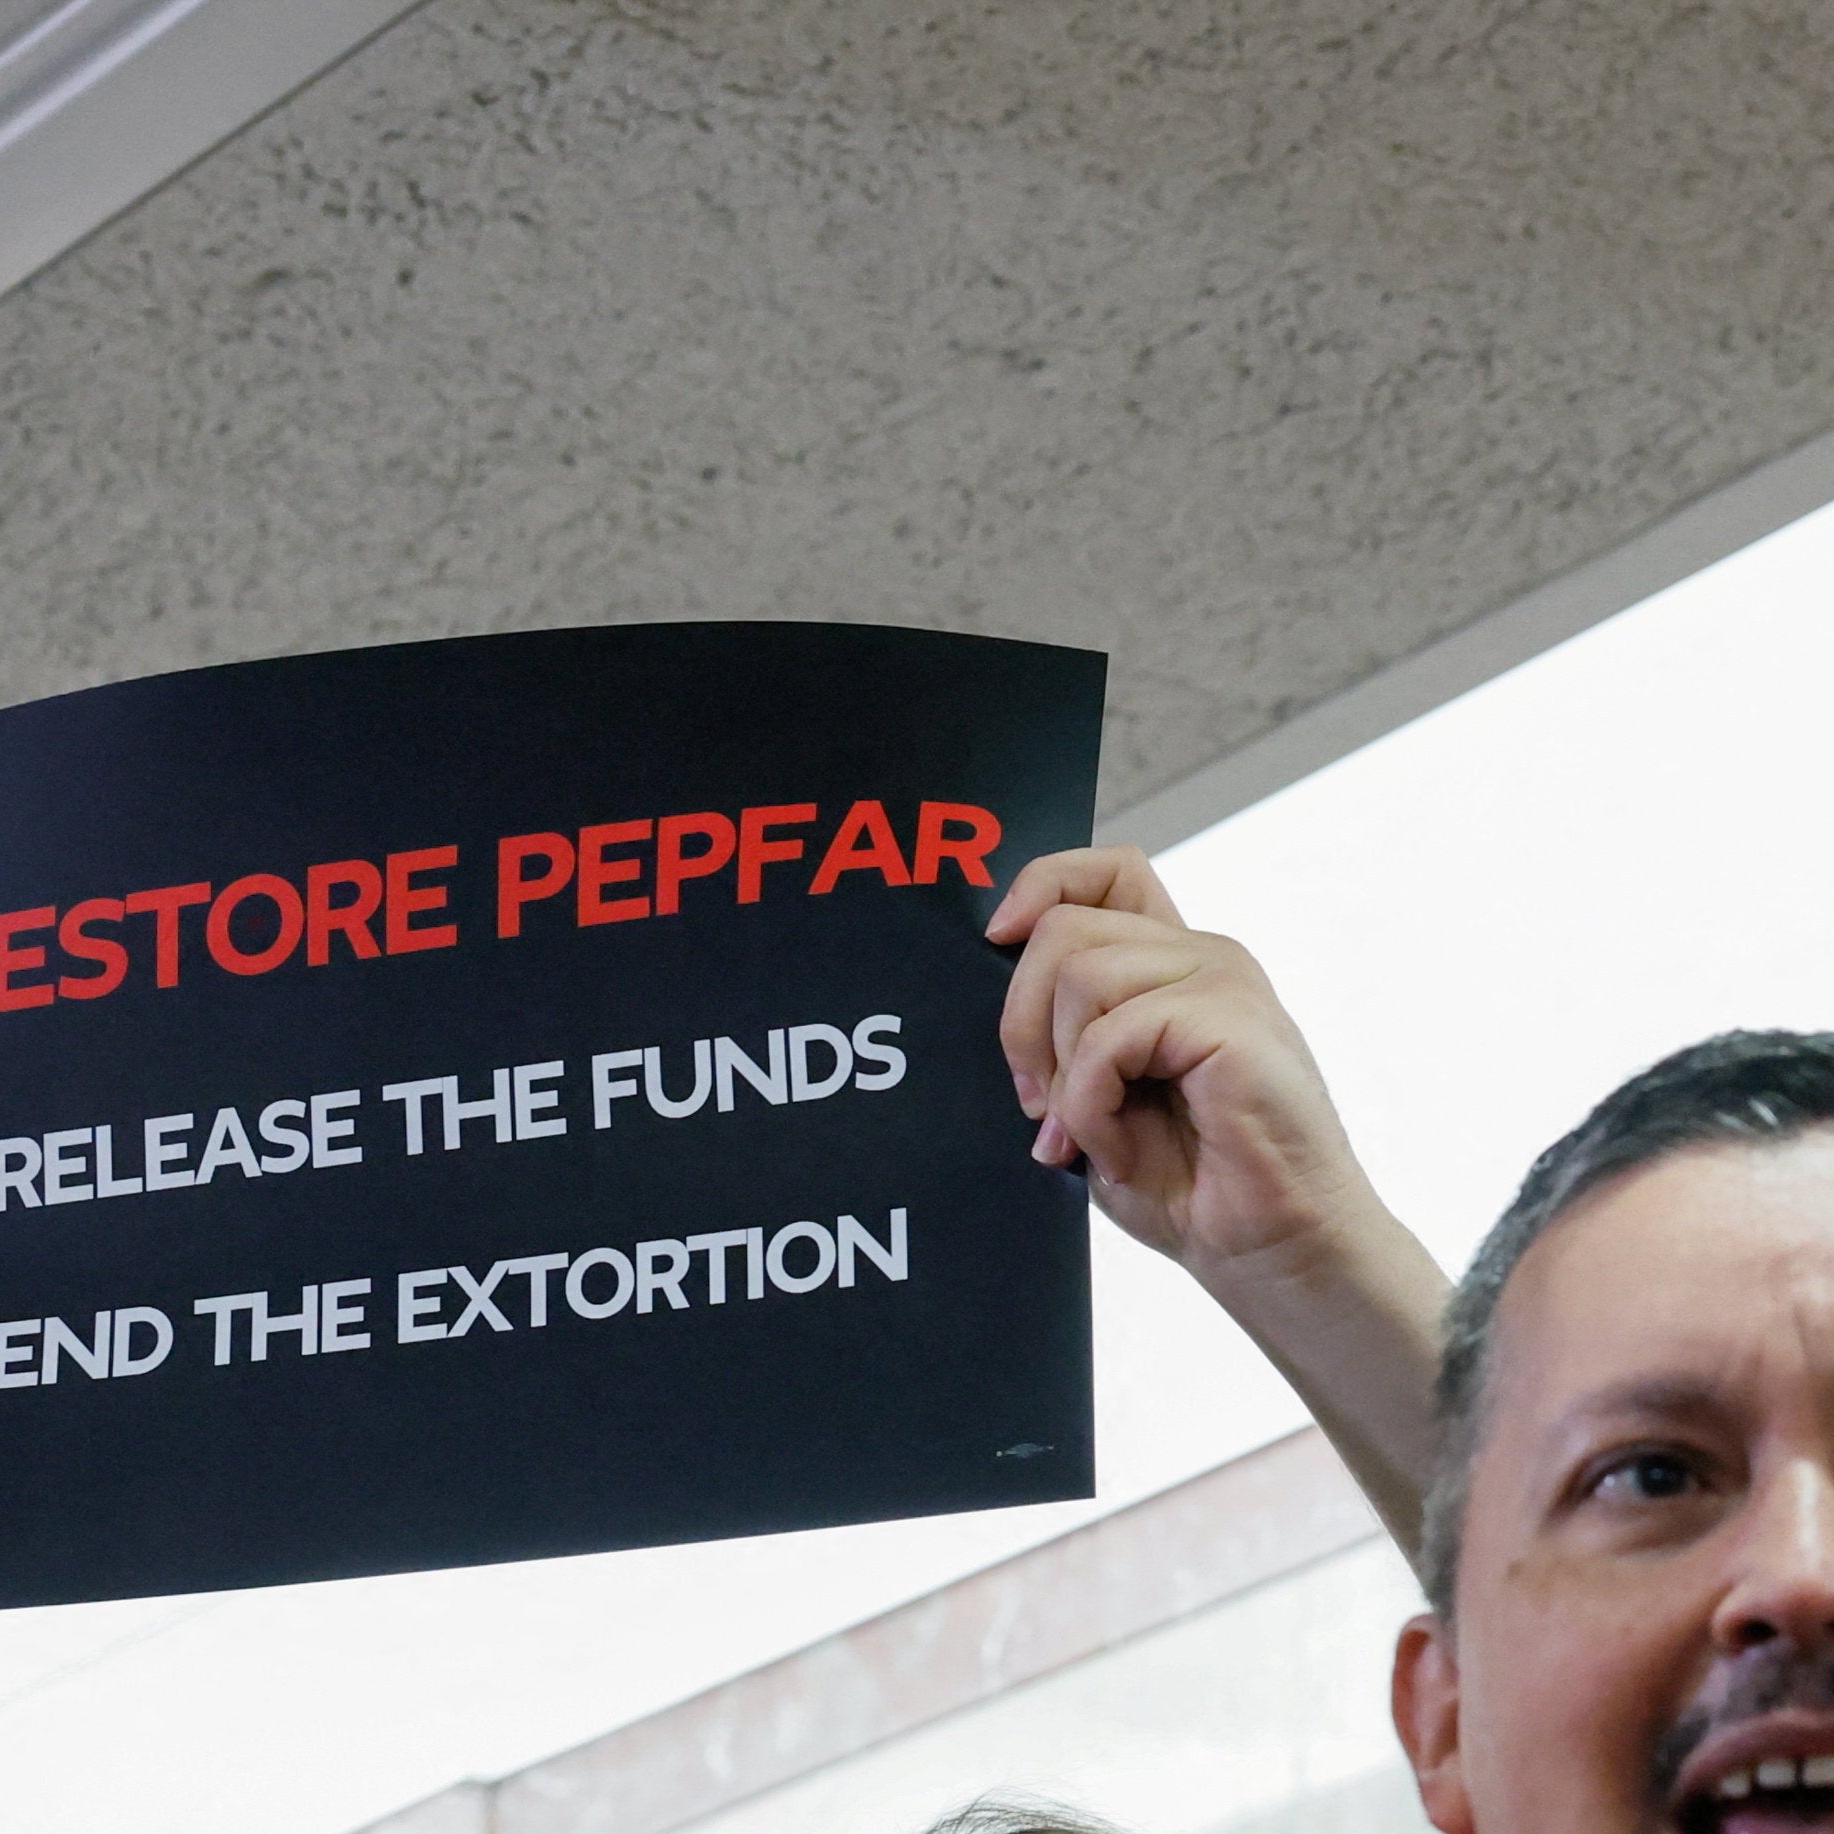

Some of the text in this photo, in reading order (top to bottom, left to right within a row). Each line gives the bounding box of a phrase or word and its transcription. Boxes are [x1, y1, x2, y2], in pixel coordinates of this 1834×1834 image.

[496, 798, 1004, 939] PEPFAR
[381, 1058, 569, 1156] THE
[590, 1013, 908, 1130] FUNDS
[192, 1276, 373, 1366] THE
[396, 1206, 910, 1344] EXTORTION
